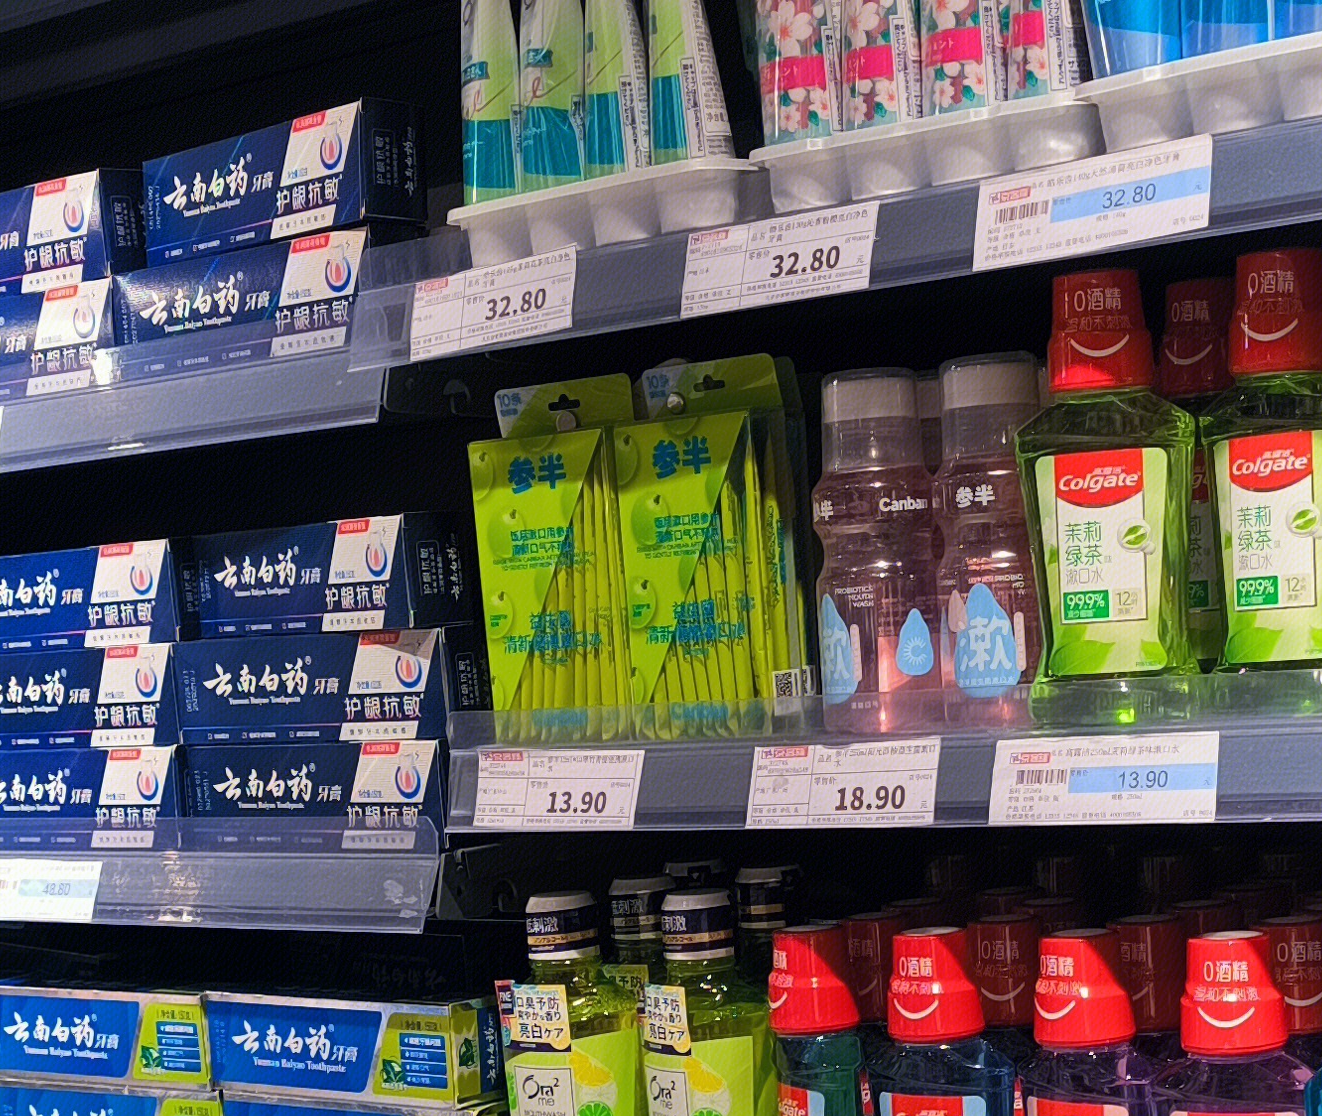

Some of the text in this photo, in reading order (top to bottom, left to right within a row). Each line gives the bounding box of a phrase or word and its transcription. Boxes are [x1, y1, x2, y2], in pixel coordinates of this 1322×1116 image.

[275, 177, 340, 212] 护龈抗敏
[1101, 183, 1157, 210] 32.80
[23, 241, 85, 272] 护龈抗敏
[770, 245, 841, 278] 32.80
[275, 299, 350, 333] 护龈抗敏
[484, 288, 546, 321] 32.80
[651, 434, 712, 478] 参半
[1231, 452, 1310, 476] Colgate
[507, 453, 567, 493] 参半
[1057, 471, 1141, 494] Colgate
[955, 484, 995, 506] 参半
[1236, 506, 1273, 528] 茉莉
[1064, 521, 1103, 543] 茉莉
[1235, 530, 1273, 550] 绿茶
[325, 585, 387, 611] 护龈抗敏
[1235, 578, 1275, 596] 99.9%
[1064, 593, 1106, 611] 99.9%
[87, 603, 152, 628] 护龈抗敏
[344, 696, 421, 722] 护龈抗敏
[1117, 770, 1169, 790] 13.90
[545, 789, 608, 815] 13.90
[833, 784, 906, 811] 18.90
